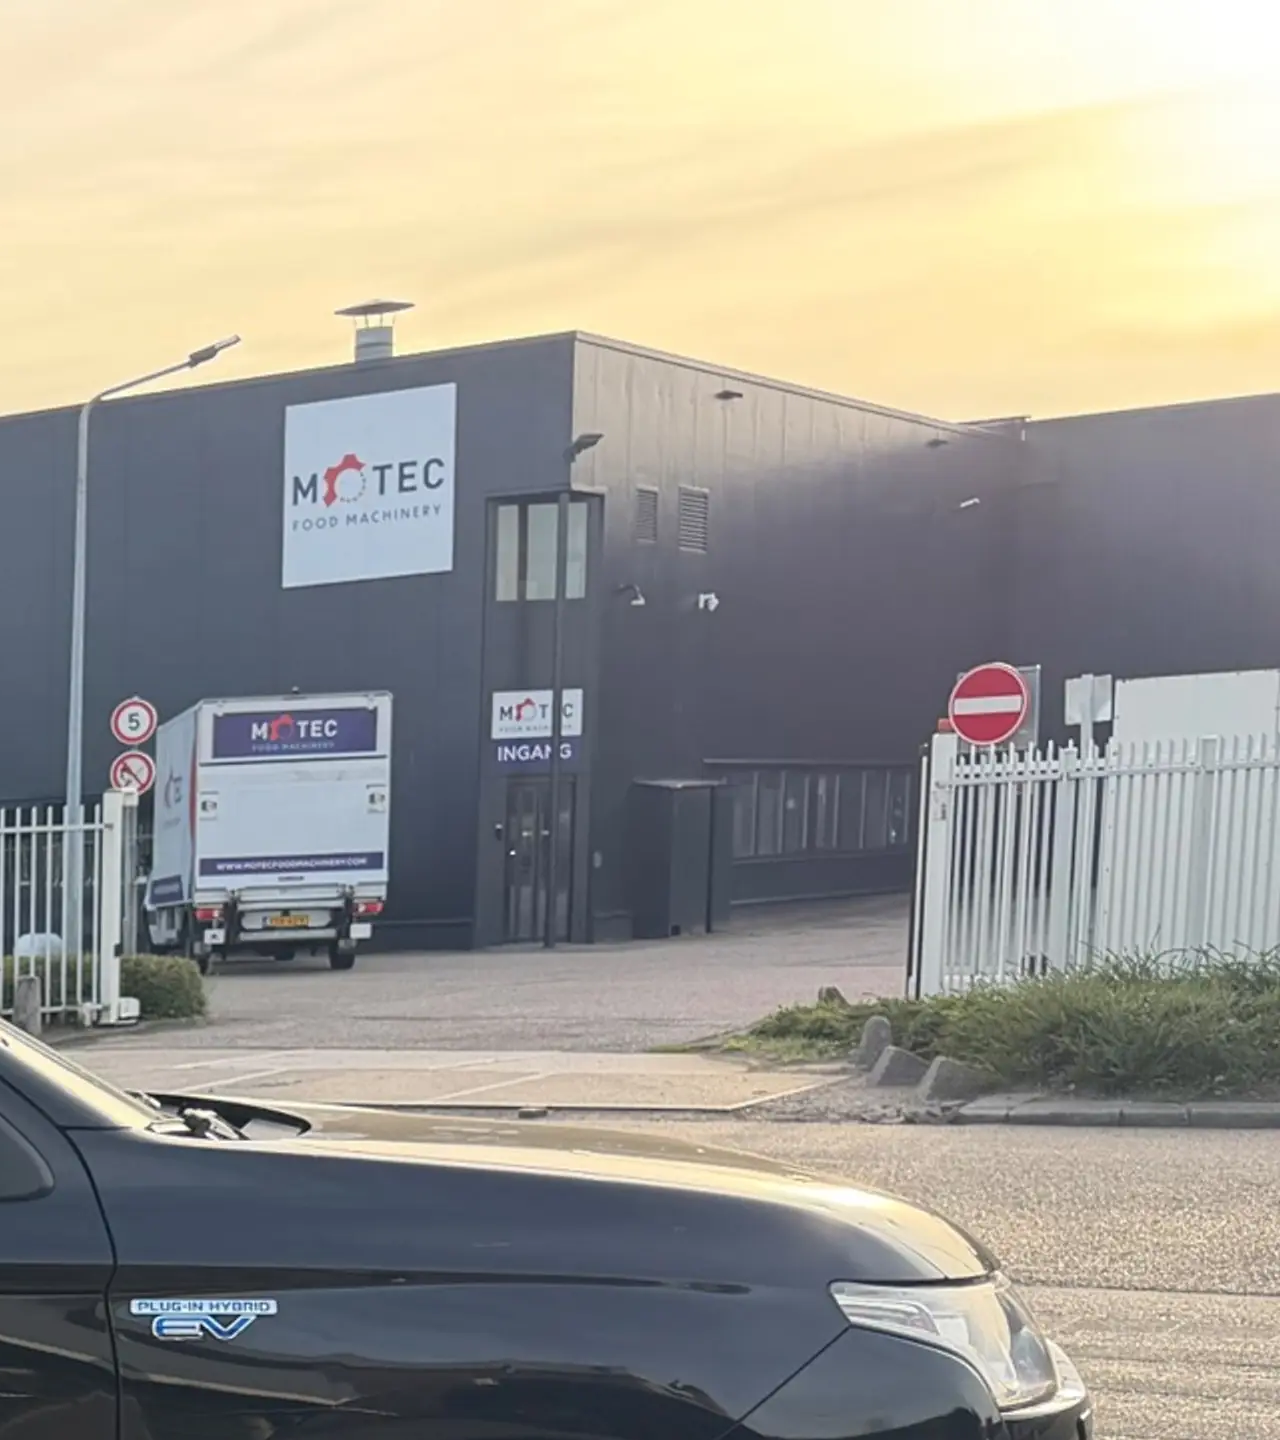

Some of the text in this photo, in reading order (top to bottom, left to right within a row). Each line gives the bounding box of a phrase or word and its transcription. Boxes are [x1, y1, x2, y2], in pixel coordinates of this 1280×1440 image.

[292, 453, 445, 507] MOTEC
[292, 504, 442, 532] FOOD MACHINERY
[500, 697, 574, 721] MOTC
[127, 713, 141, 731] 5
[138, 1301, 272, 1312] PLUG-IN HYBRID
[152, 1315, 258, 1340] EV
